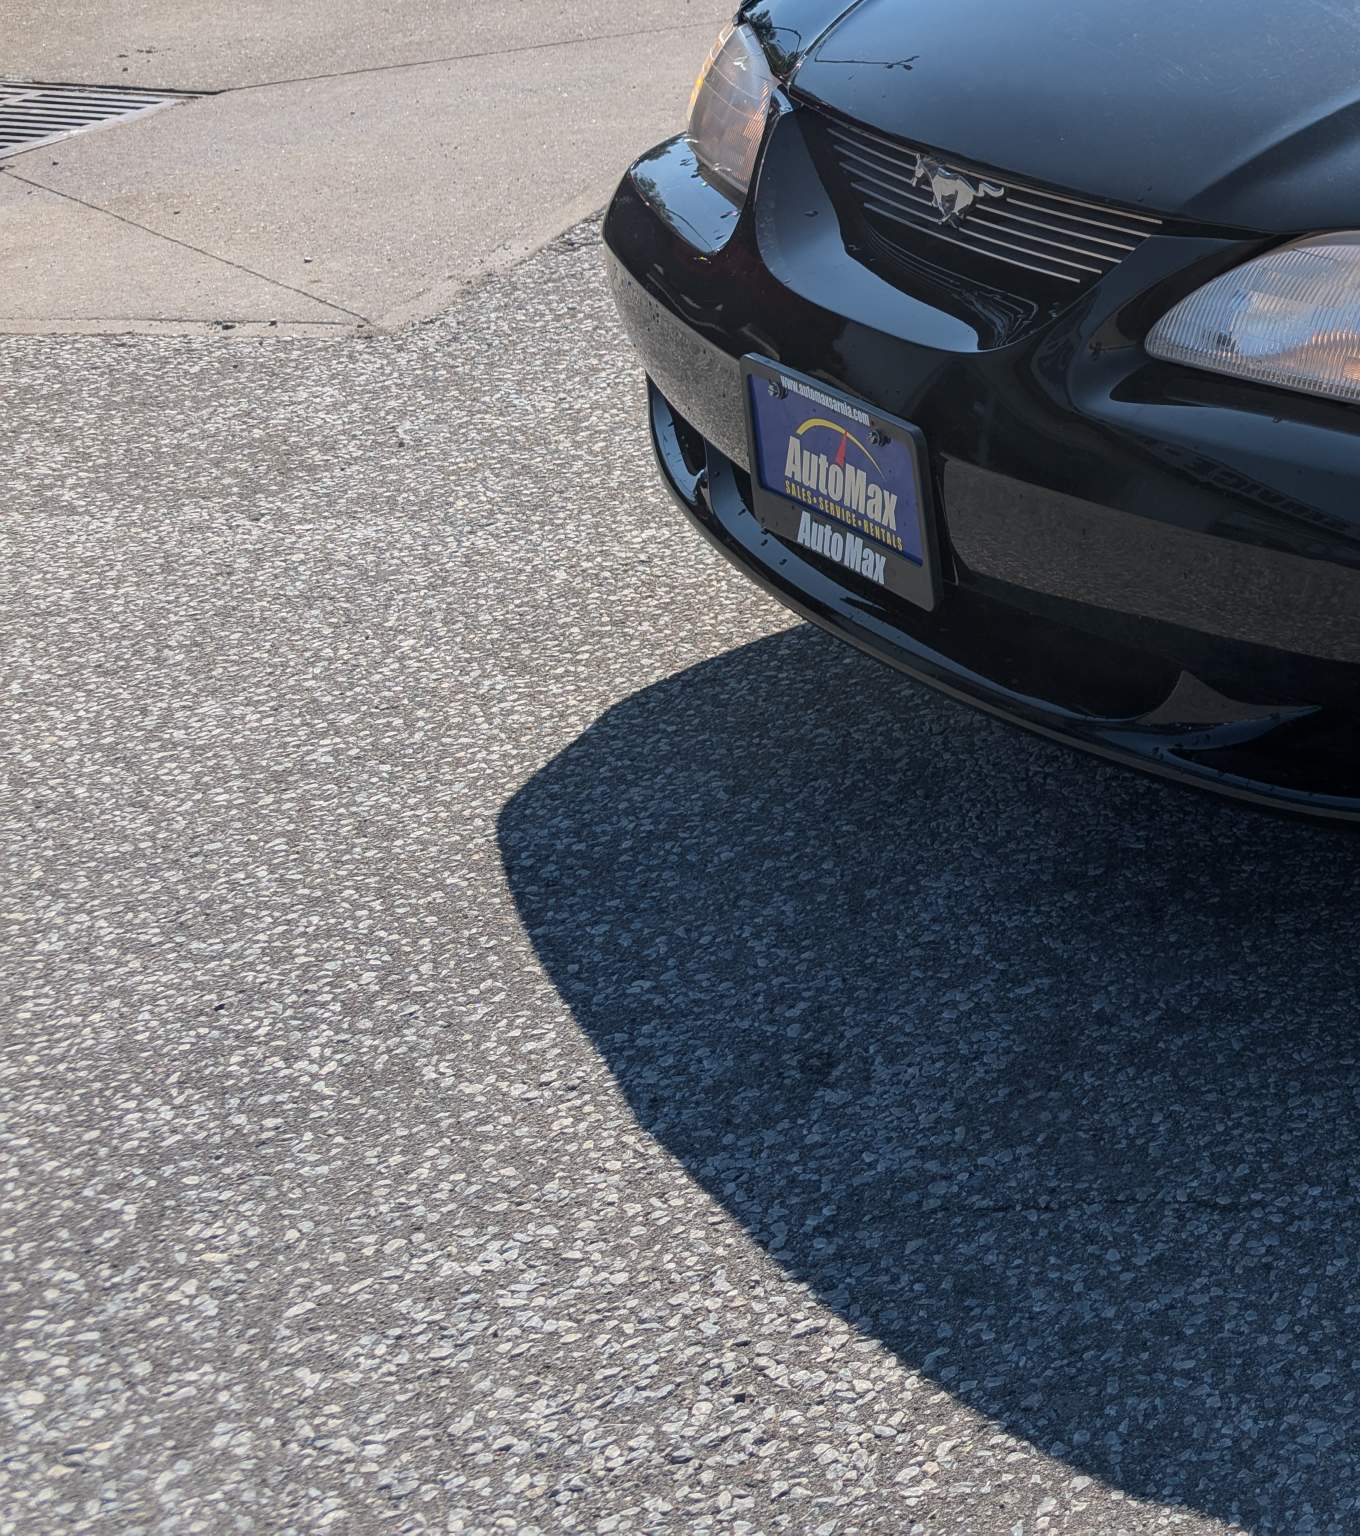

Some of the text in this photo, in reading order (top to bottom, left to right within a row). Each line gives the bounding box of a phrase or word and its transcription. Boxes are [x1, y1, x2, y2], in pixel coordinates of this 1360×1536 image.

[780, 375, 871, 428] www.automaxsarnia.com
[784, 435, 898, 532] AutoMax
[785, 480, 812, 506] SALES
[818, 496, 858, 528] SERVICE
